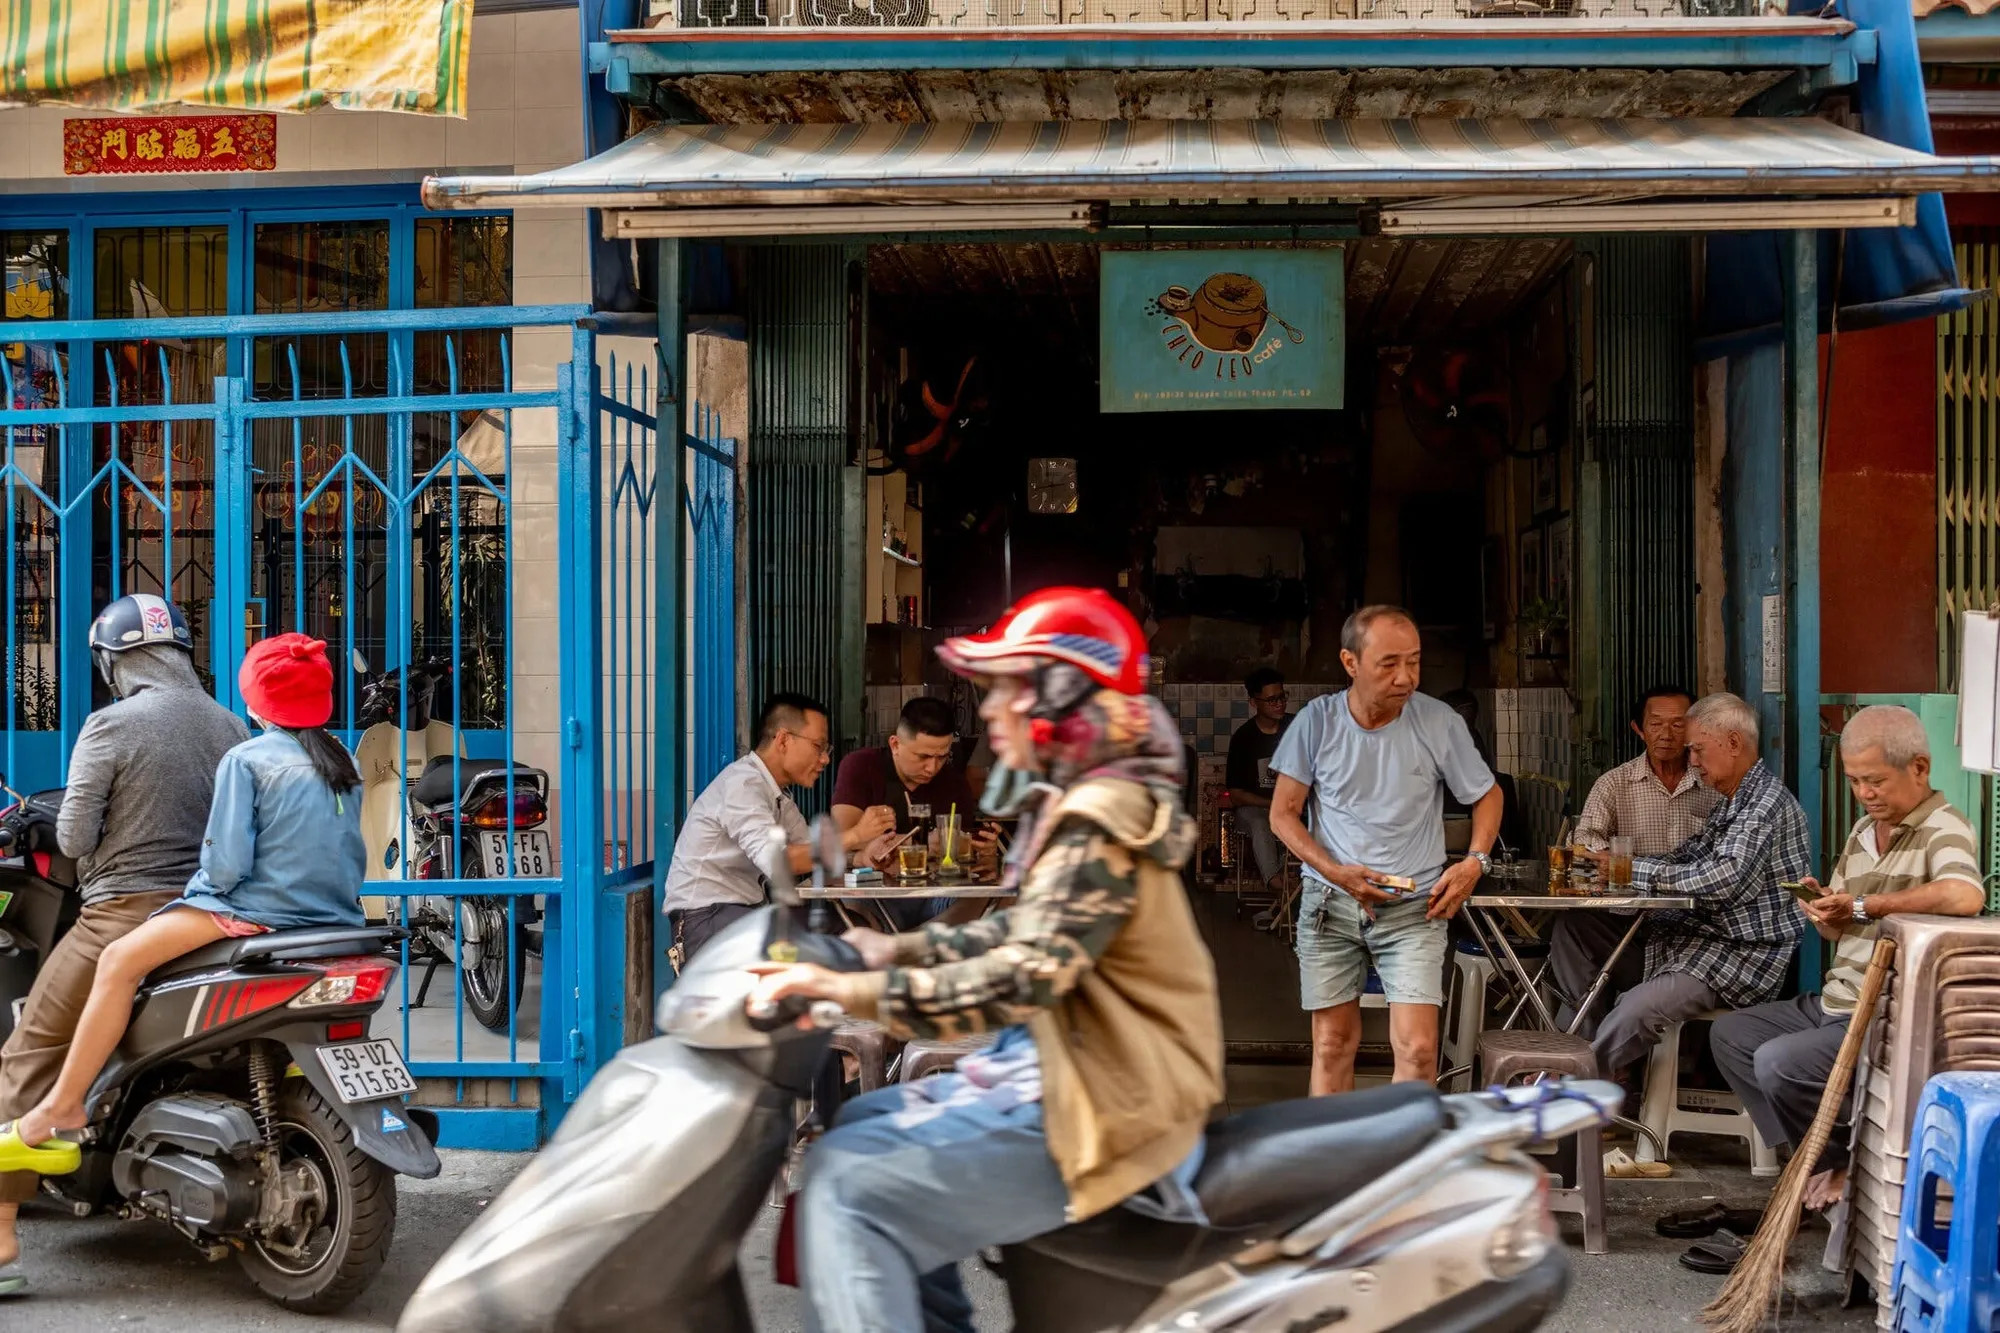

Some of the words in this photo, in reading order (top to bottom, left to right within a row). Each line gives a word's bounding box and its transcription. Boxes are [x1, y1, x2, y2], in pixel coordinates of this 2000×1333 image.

[1162, 324, 1204, 370] CHEO
[1216, 355, 1252, 380] LEO
[1253, 337, 1282, 364] café
[492, 833, 540, 854] 51-F4
[495, 855, 543, 876] 868
[331, 1044, 393, 1070] 59-U2
[339, 1067, 410, 1097] 515.63
